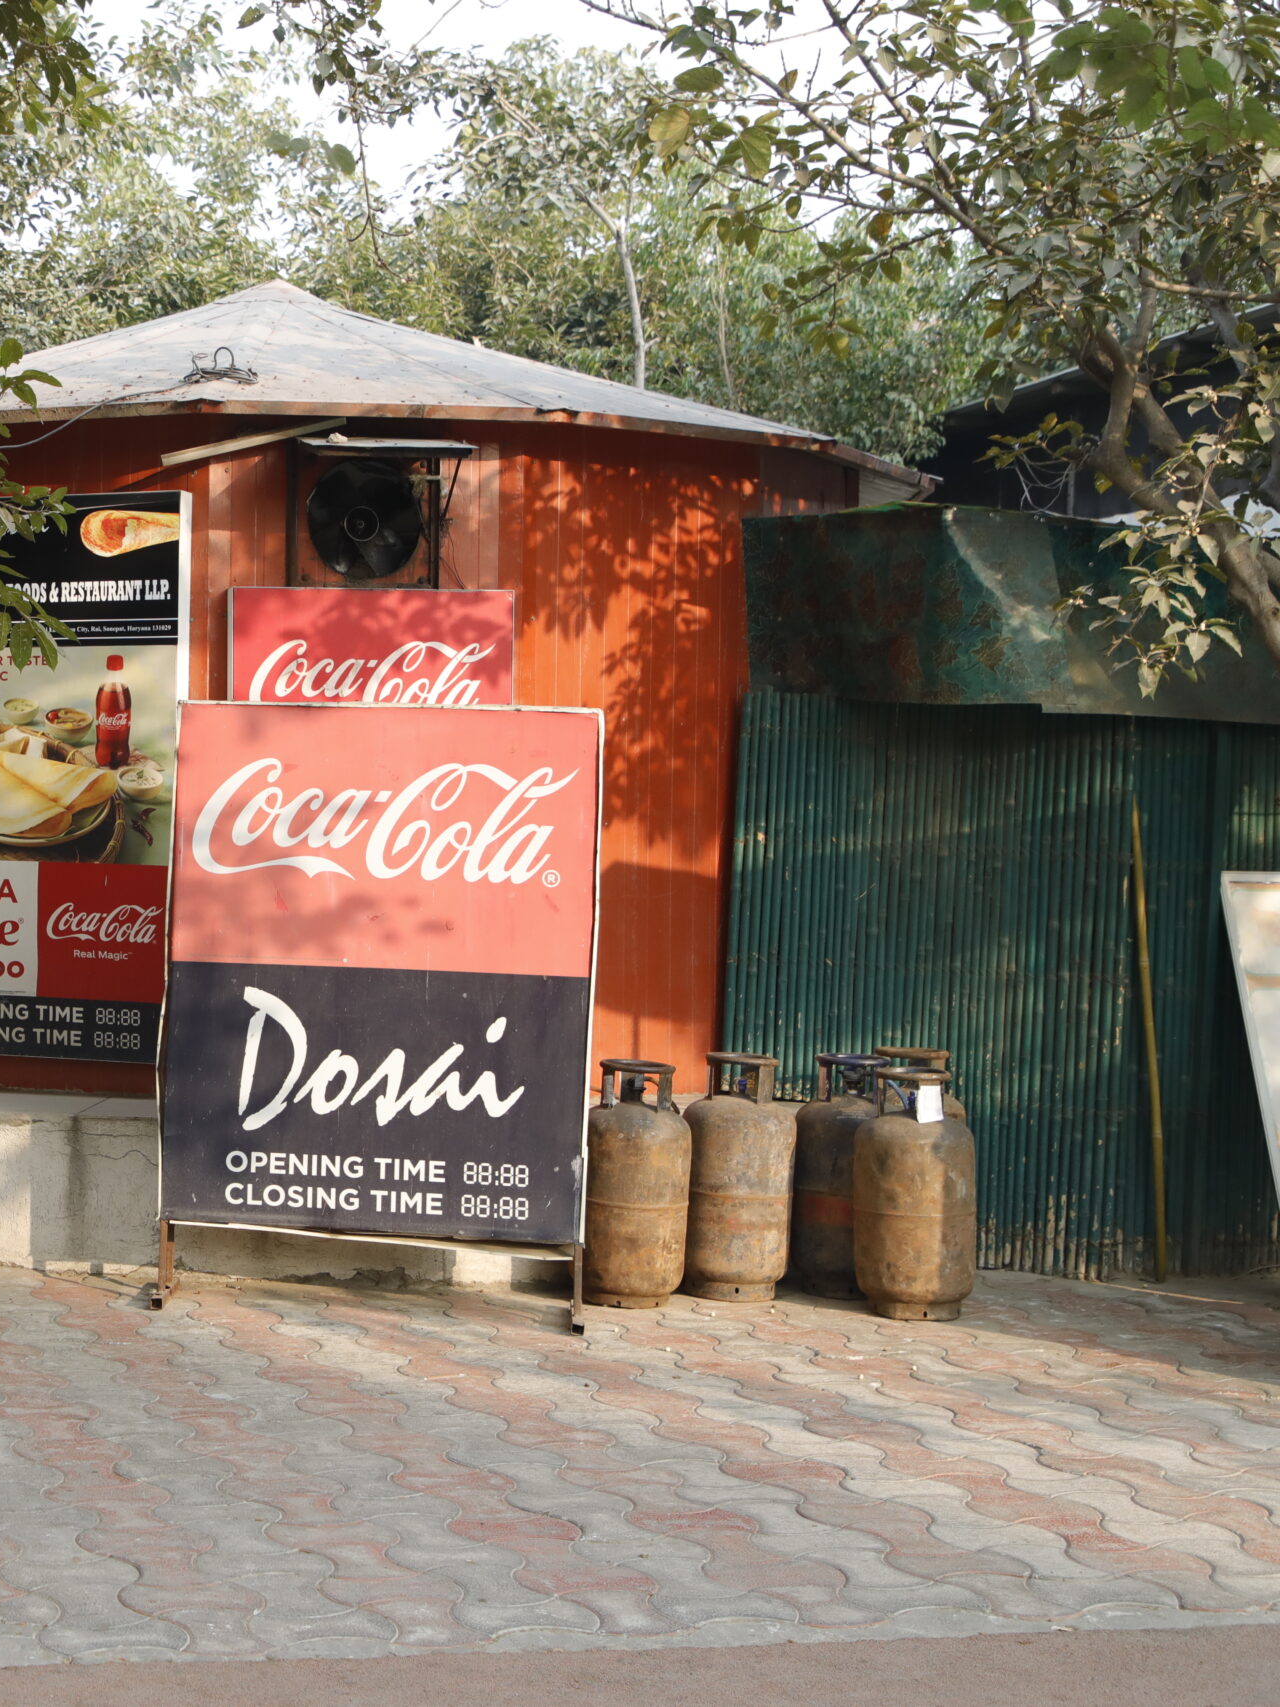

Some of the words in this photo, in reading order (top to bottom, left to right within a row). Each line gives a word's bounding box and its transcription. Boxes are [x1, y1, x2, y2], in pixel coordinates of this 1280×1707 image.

[49, 582, 58, 603] &
[61, 580, 142, 602] RESTAURANT
[145, 579, 171, 600] LLP.
[127, 625, 151, 633] Haryana
[7, 655, 51, 667] TSTE
[249, 639, 496, 704] Coca-Cola
[98, 711, 128, 726] Coca-Cola
[192, 757, 580, 885] Coca-Cola
[46, 902, 163, 943] Coca-Cola
[73, 949, 96, 959] Real
[98, 950, 129, 961] Magic
[36, 1005, 84, 1024] TIME
[95, 1007, 140, 1026] 88:88
[33, 1028, 82, 1047] TIME
[94, 1031, 140, 1050] 88:88
[238, 986, 524, 1131] Dosai
[225, 1150, 363, 1179] OPENING
[373, 1157, 446, 1183] TIME
[463, 1161, 529, 1188] 88:88
[225, 1182, 360, 1211] CLOSING
[370, 1189, 443, 1215] TIME
[460, 1194, 529, 1220] 88:88
